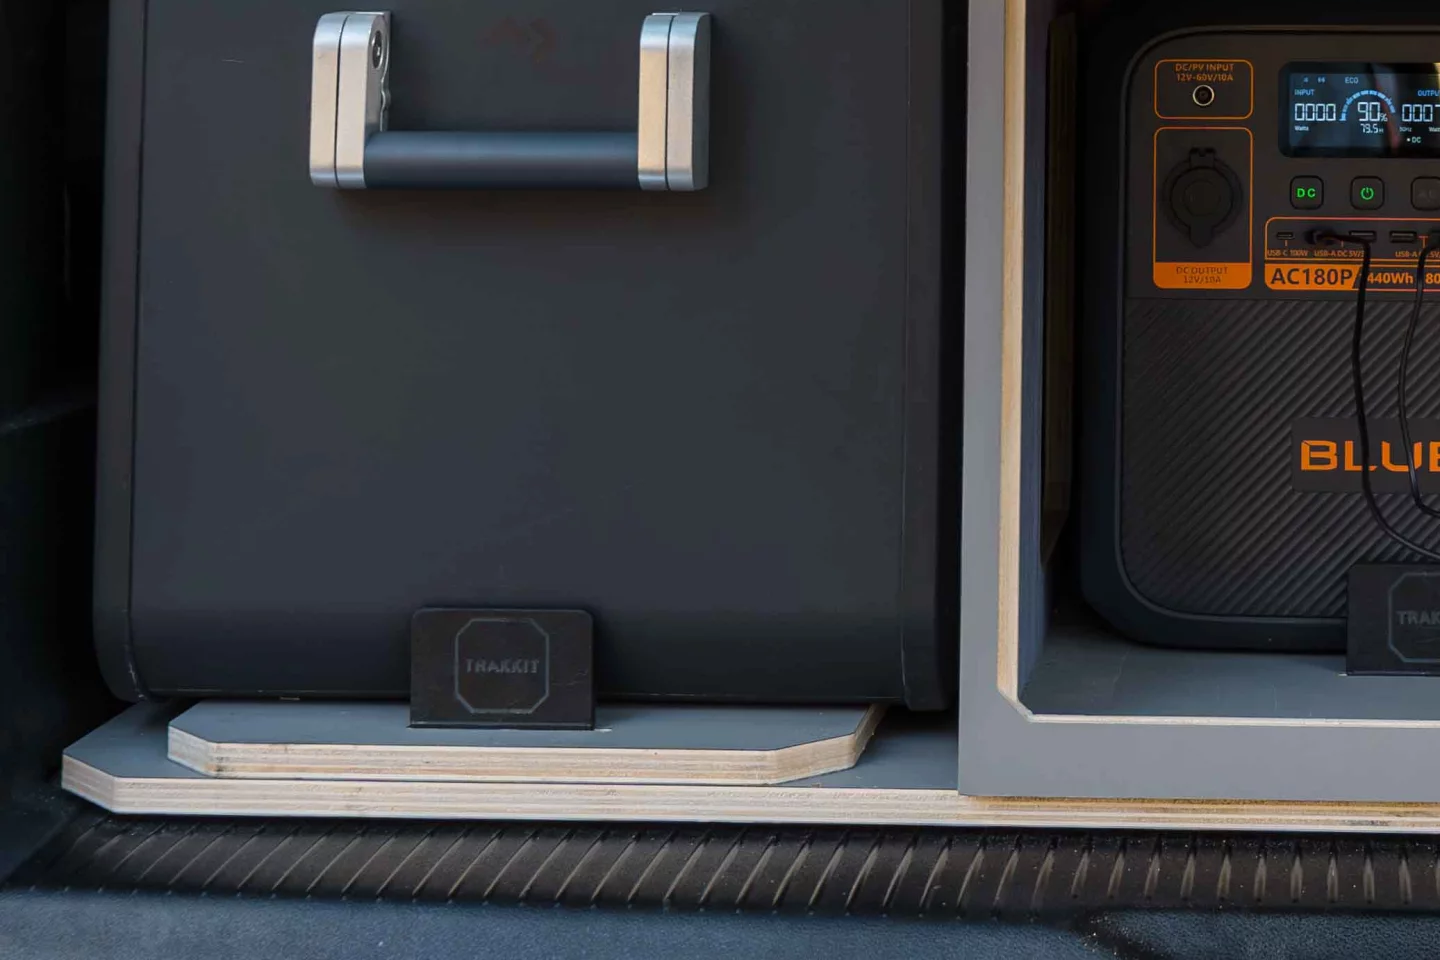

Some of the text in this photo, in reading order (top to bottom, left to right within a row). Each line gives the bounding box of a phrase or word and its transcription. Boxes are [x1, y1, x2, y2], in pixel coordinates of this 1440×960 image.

[1175, 63, 1234, 72] DC/PV INPUT
[1344, 76, 1359, 84] ECO
[1294, 103, 1336, 121] 0000
[1357, 101, 1388, 122] 90%
[1411, 136, 1421, 144] DC
[1296, 188, 1316, 198] DC
[1176, 266, 1228, 275] DC OUTPUT
[1270, 268, 1354, 285] AC180P
[1362, 271, 1414, 284] 440Wh
[465, 658, 540, 674] TRAKKIT
